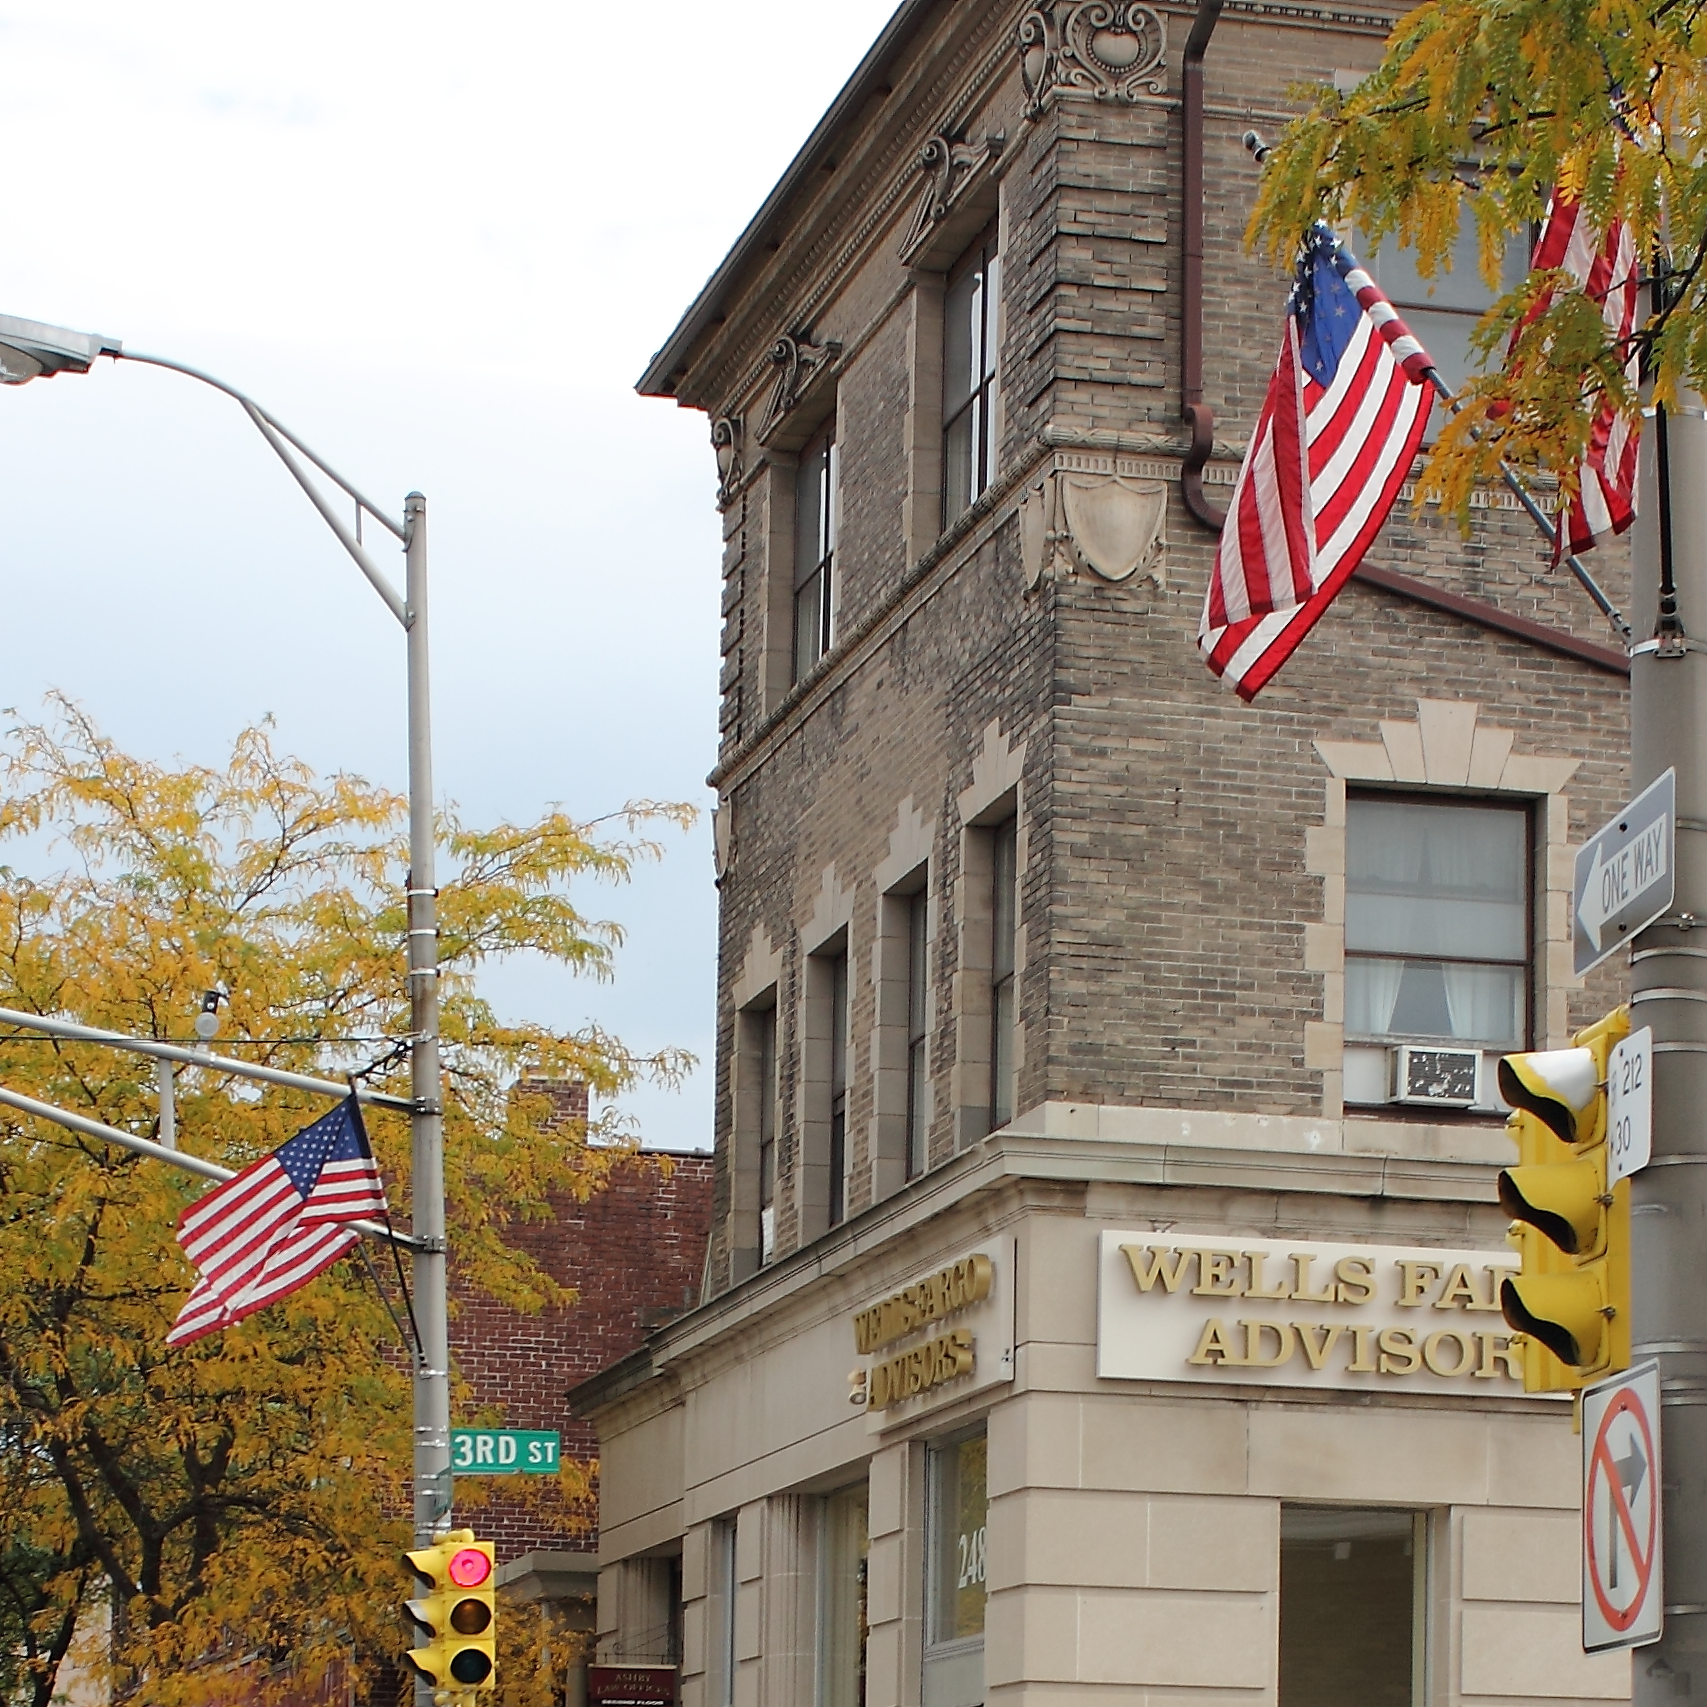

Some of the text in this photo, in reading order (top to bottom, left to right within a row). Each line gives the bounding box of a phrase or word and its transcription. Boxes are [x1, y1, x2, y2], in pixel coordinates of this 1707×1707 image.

[1601, 822, 1663, 914] ONE WAY
[1622, 1053, 1642, 1097] 212
[1616, 1115, 1631, 1156] 30
[1119, 1243, 1377, 1306] WELLS
[1186, 1318, 1524, 1381] ADVISOR
[454, 1434, 556, 1467] 3RD ST
